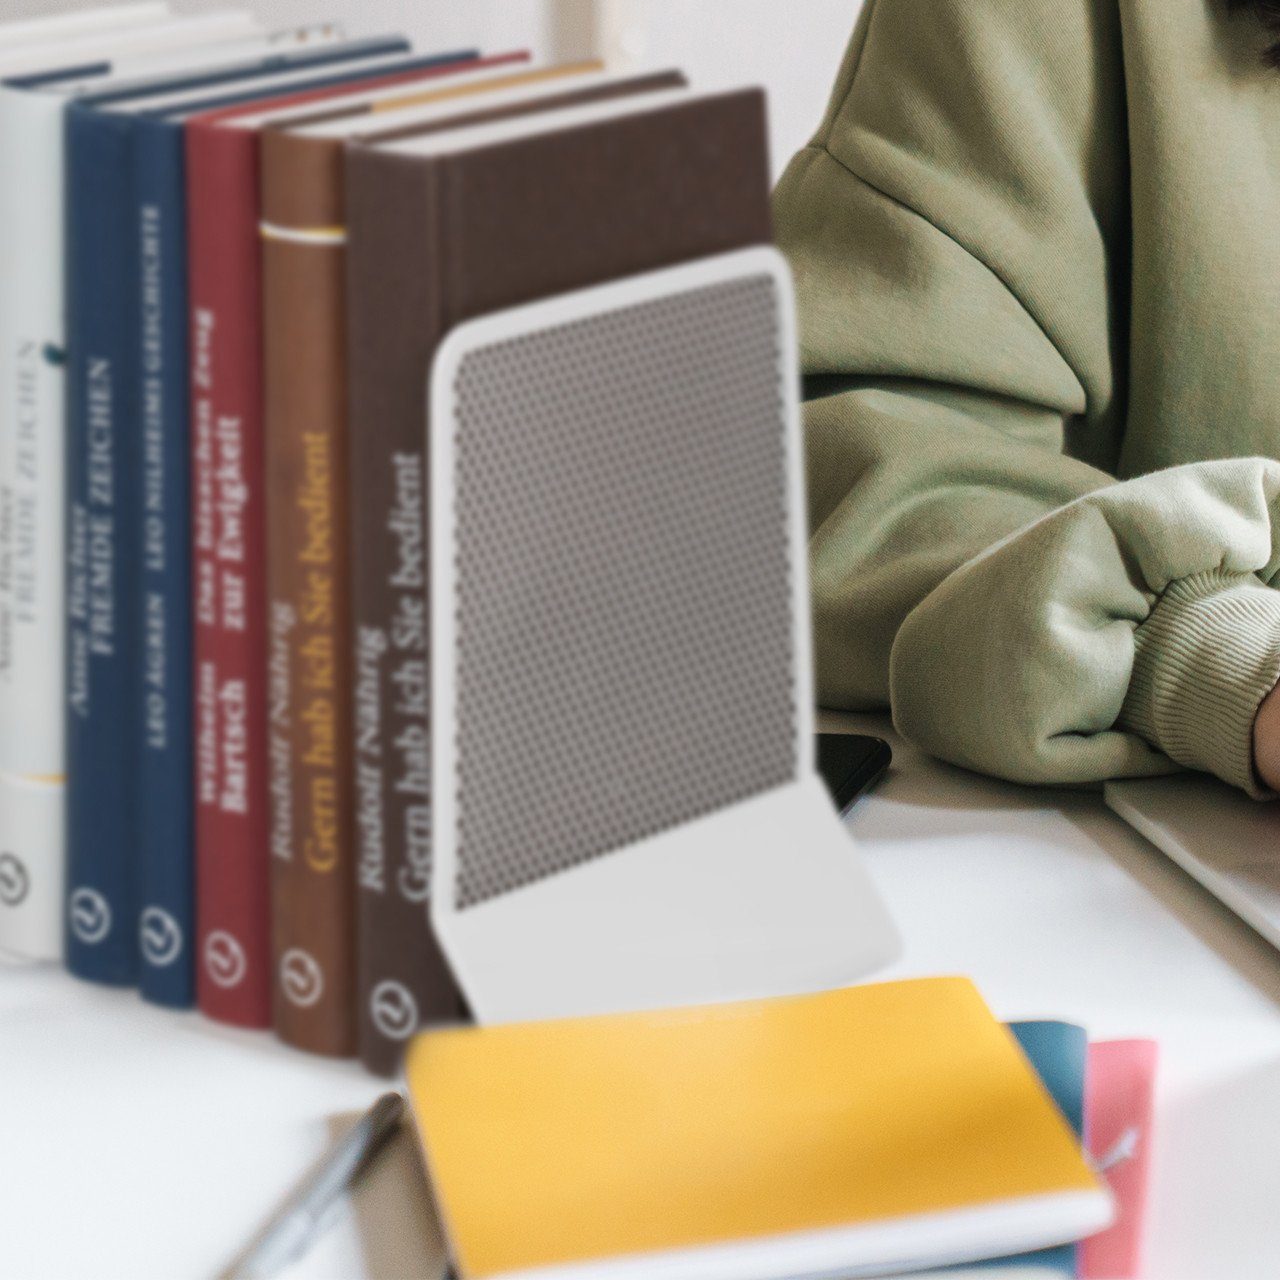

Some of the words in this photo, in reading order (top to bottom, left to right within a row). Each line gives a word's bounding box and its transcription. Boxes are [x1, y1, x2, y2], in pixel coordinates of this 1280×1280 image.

[87, 357, 113, 506] ZEICHEN
[216, 416, 250, 561] Ewigkeit
[297, 430, 333, 564] bedient
[387, 452, 423, 588] bedient
[89, 512, 115, 654] FREMDE
[146, 517, 165, 571] LEO
[197, 561, 215, 625] Das
[221, 571, 245, 630] zur
[299, 570, 333, 626] Sie
[391, 593, 425, 651] Sie
[299, 634, 334, 689] ich
[391, 659, 427, 716] ich
[147, 694, 167, 748] LEO
[219, 679, 247, 814] Bartsch
[301, 697, 335, 767] hab
[393, 724, 428, 794] hab
[270, 734, 294, 863] Rudolf
[303, 776, 337, 873] Gern
[356, 761, 385, 893] Rudolf
[397, 804, 431, 904] Gern
